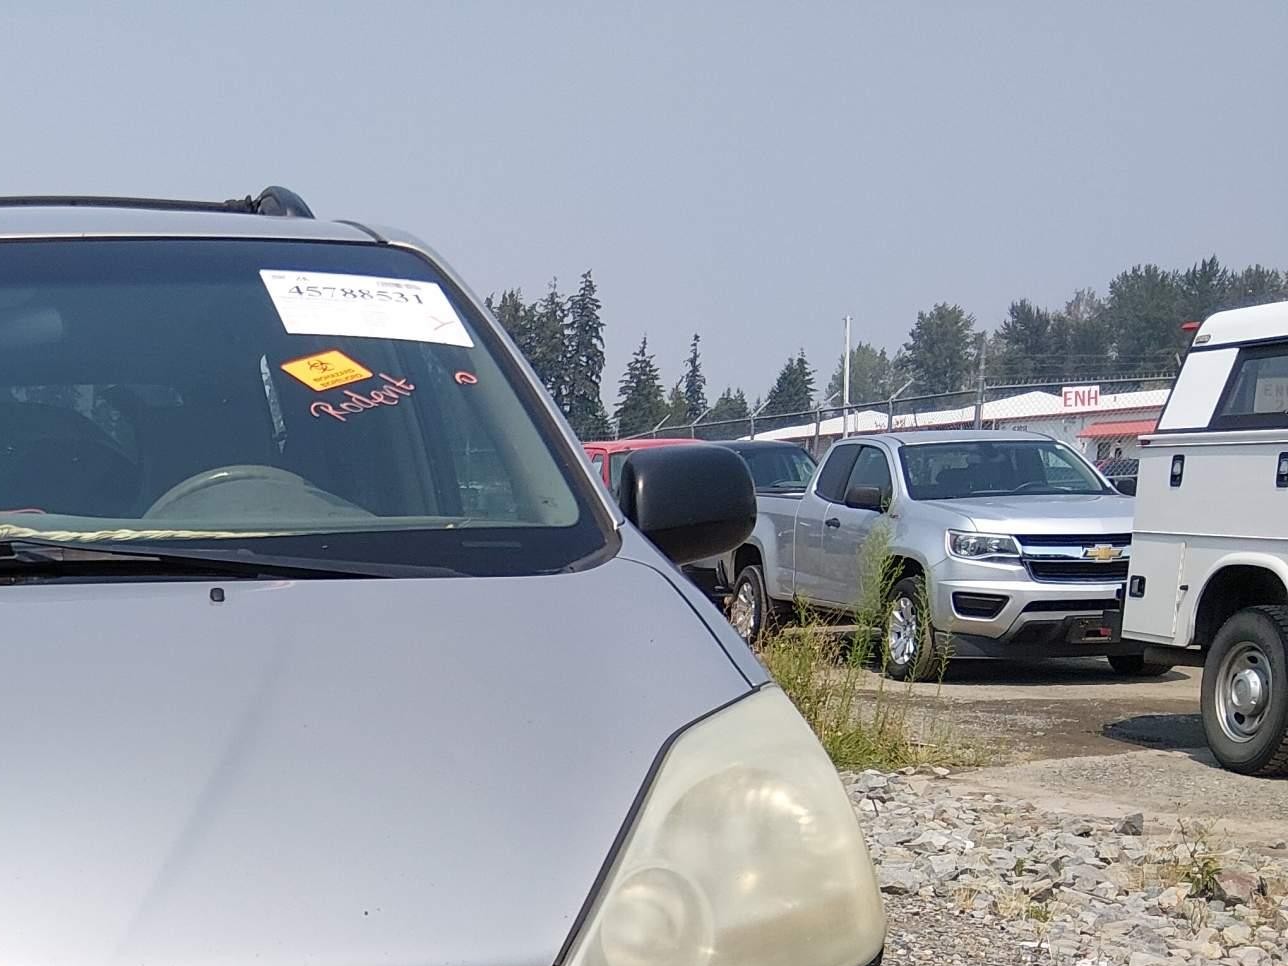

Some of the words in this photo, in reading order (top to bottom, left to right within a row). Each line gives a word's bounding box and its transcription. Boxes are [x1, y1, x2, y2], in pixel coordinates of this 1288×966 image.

[288, 285, 423, 304] 45788531
[310, 372, 415, 422] Rodent
[1063, 389, 1098, 407] ENH
